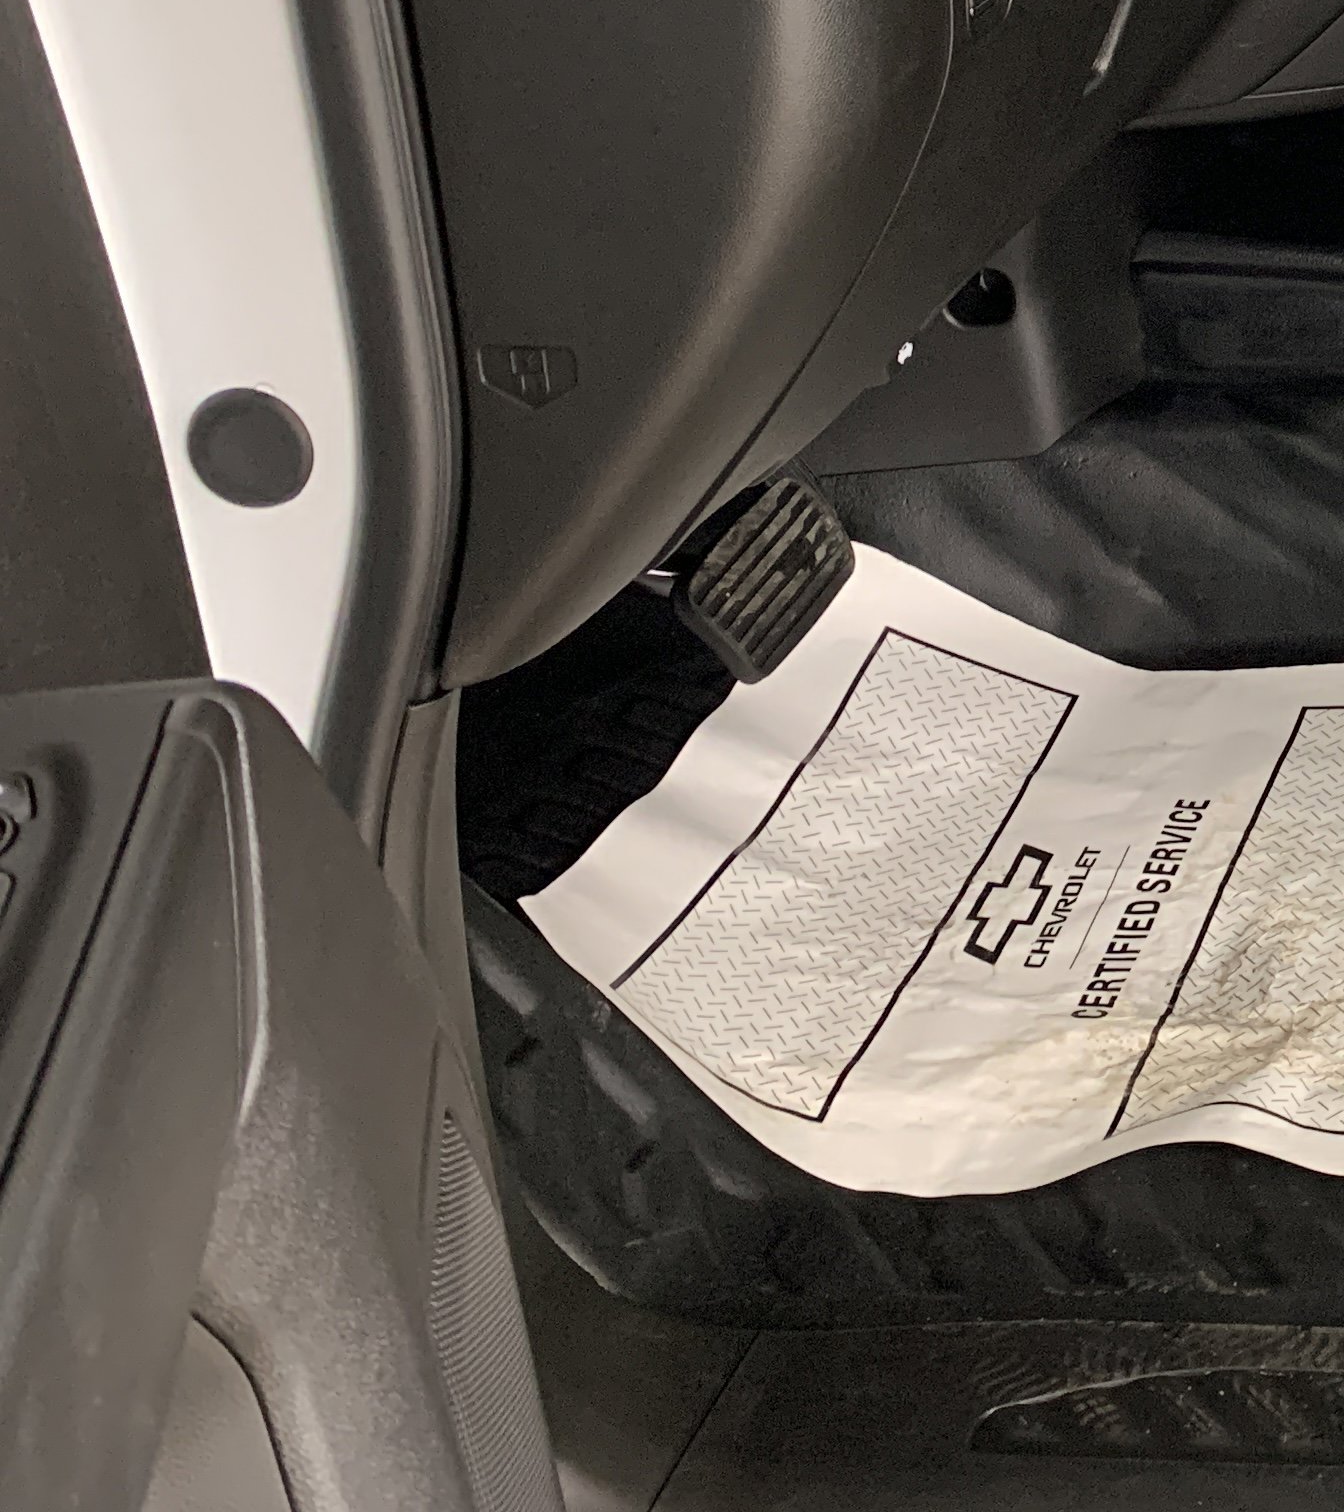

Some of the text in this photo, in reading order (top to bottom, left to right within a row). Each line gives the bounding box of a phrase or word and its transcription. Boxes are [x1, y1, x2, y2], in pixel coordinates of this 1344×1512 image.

[1024, 846, 1101, 968] CHEVROLET
[1071, 799, 1210, 1019] CERTIFIED SERVICE
